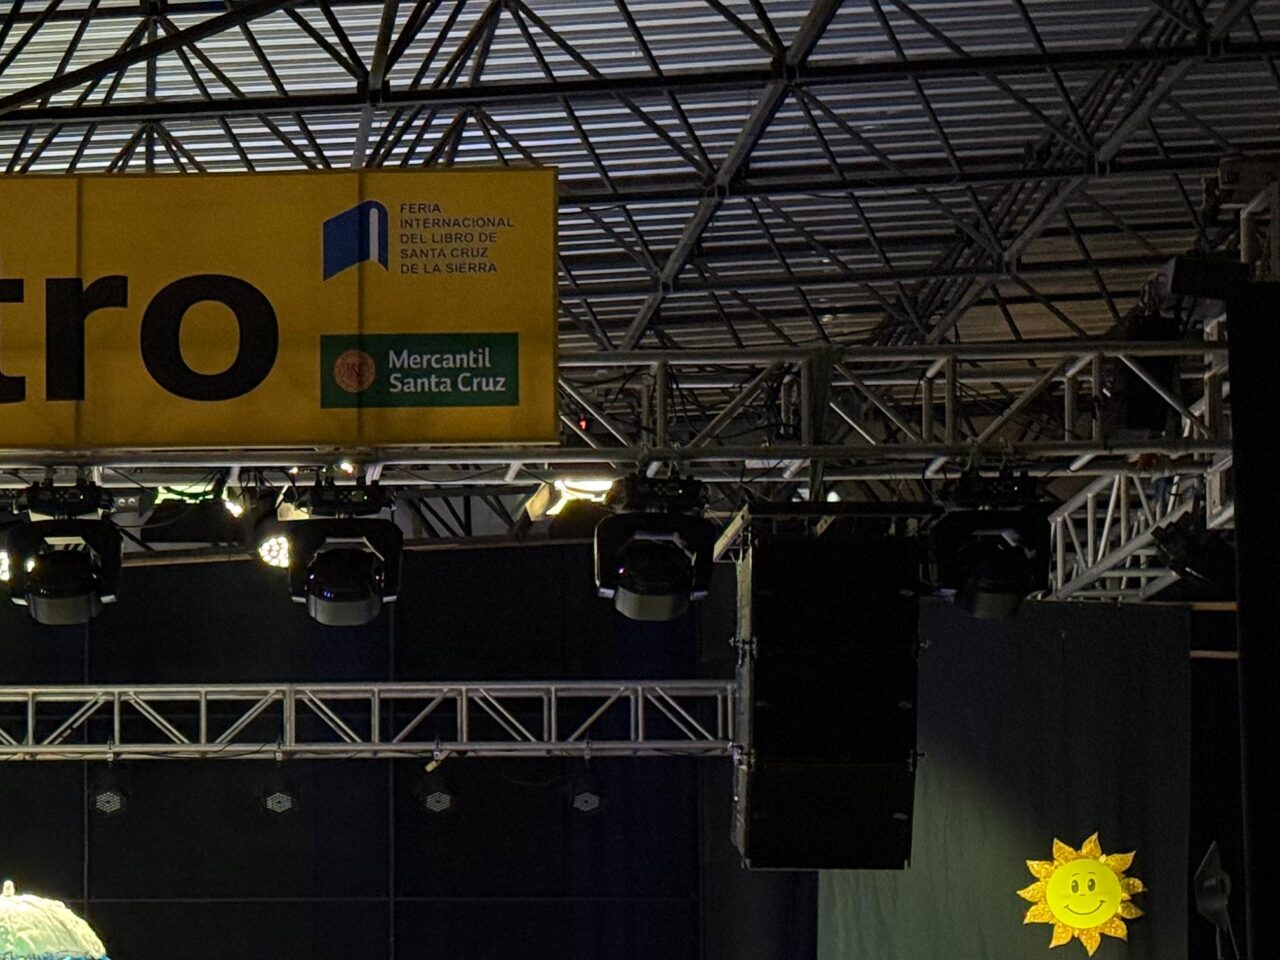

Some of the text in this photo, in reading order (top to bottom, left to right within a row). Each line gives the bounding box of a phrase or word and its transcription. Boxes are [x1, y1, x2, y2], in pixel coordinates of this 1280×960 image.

[400, 203, 441, 214] FERIA
[400, 217, 514, 228] INTERNACIONAL
[400, 231, 497, 244] DEL LIBRO DE
[400, 247, 489, 259] SANTA CRUZ
[400, 262, 497, 274] DE LA SIERRA
[388, 347, 491, 369] Mercantil
[389, 372, 506, 393] Santa Cruz
